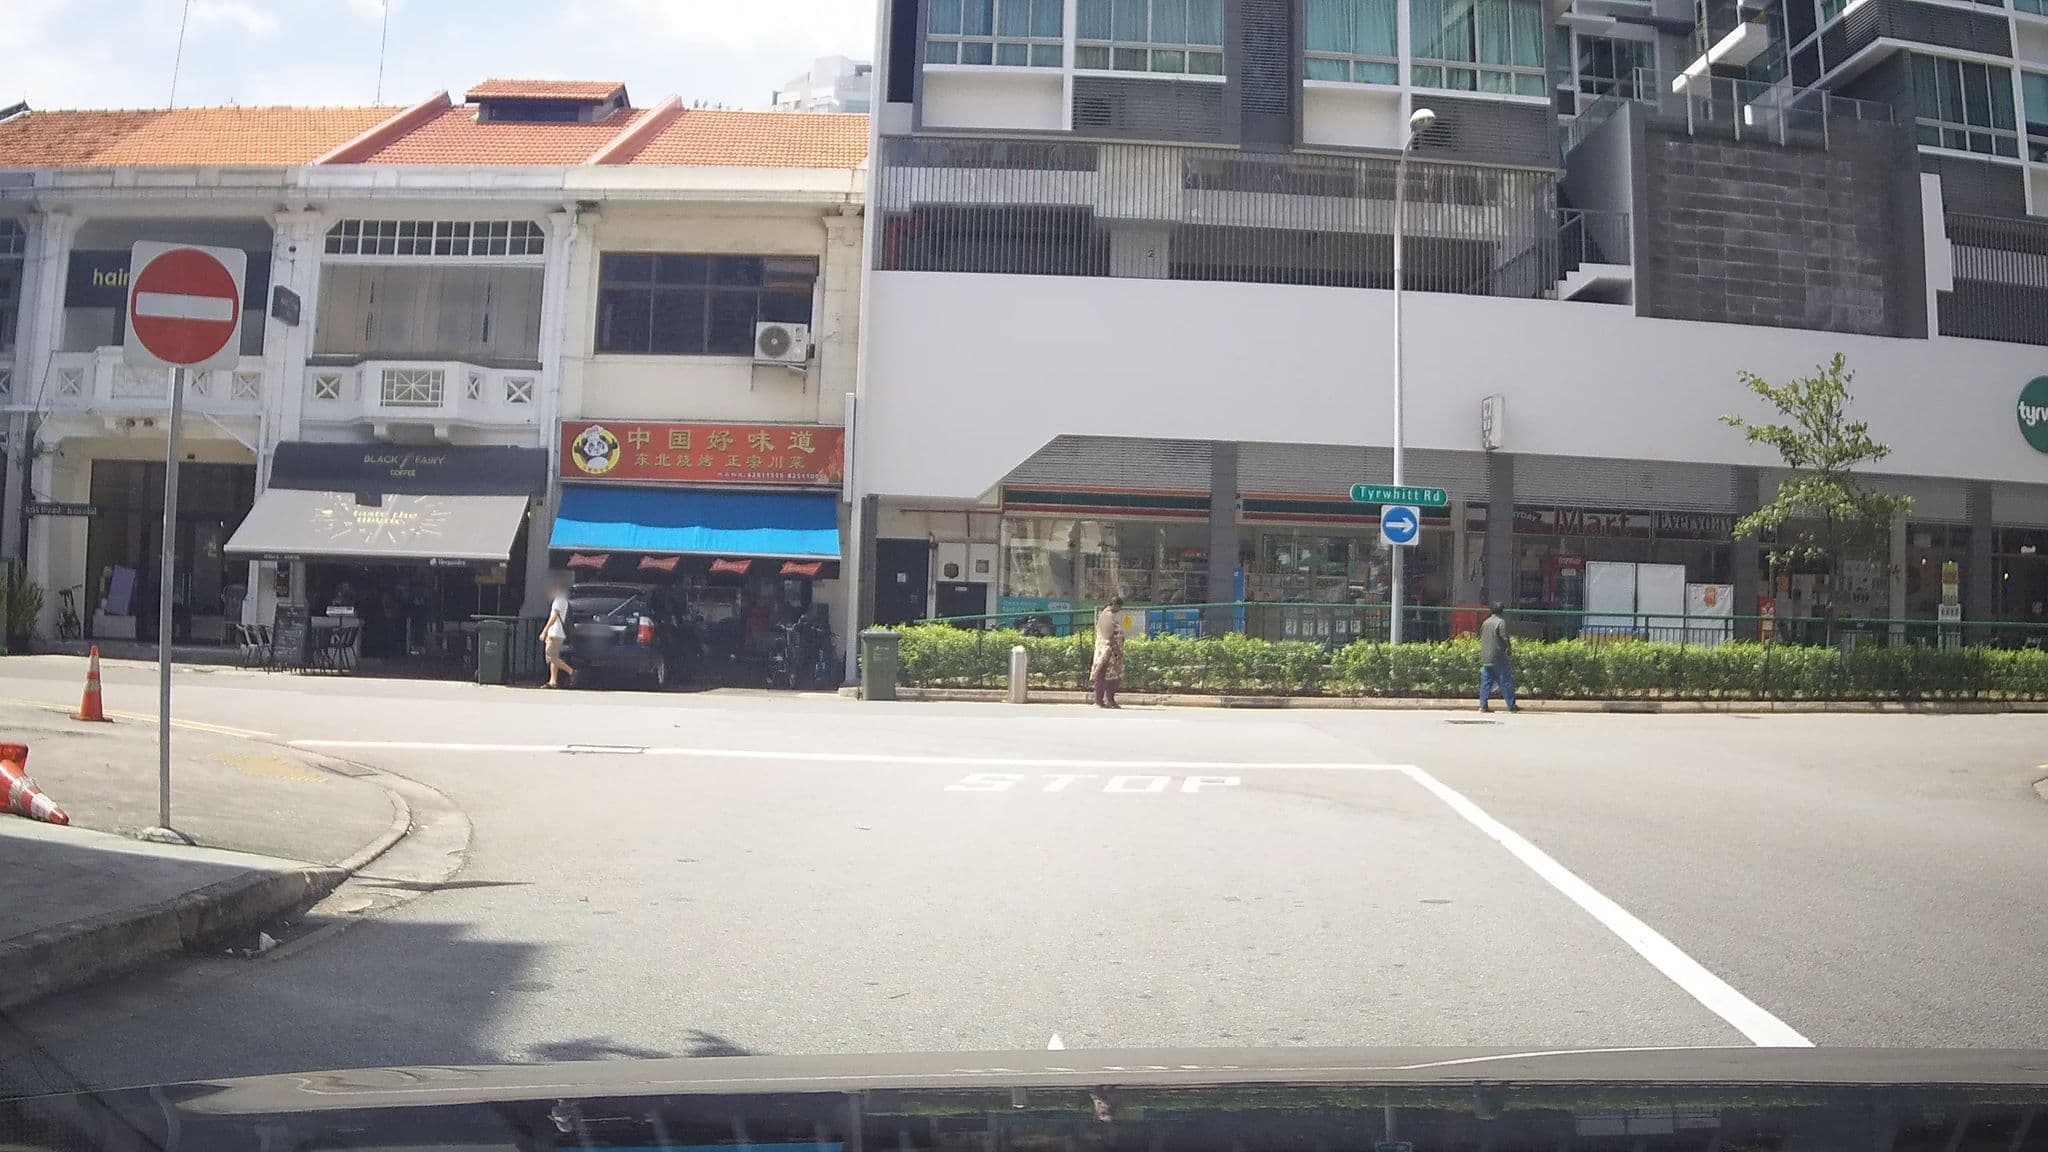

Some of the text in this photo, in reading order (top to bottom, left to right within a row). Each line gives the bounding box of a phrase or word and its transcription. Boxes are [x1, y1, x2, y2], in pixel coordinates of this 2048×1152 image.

[628, 426, 816, 453] 中国好味道
[364, 455, 445, 465] BLACK FAIRY
[390, 468, 416, 477] COFFEE
[1359, 485, 1442, 503] Tyrwhitt Rd
[1553, 506, 1632, 536] Mart
[943, 772, 1241, 793] STOP
